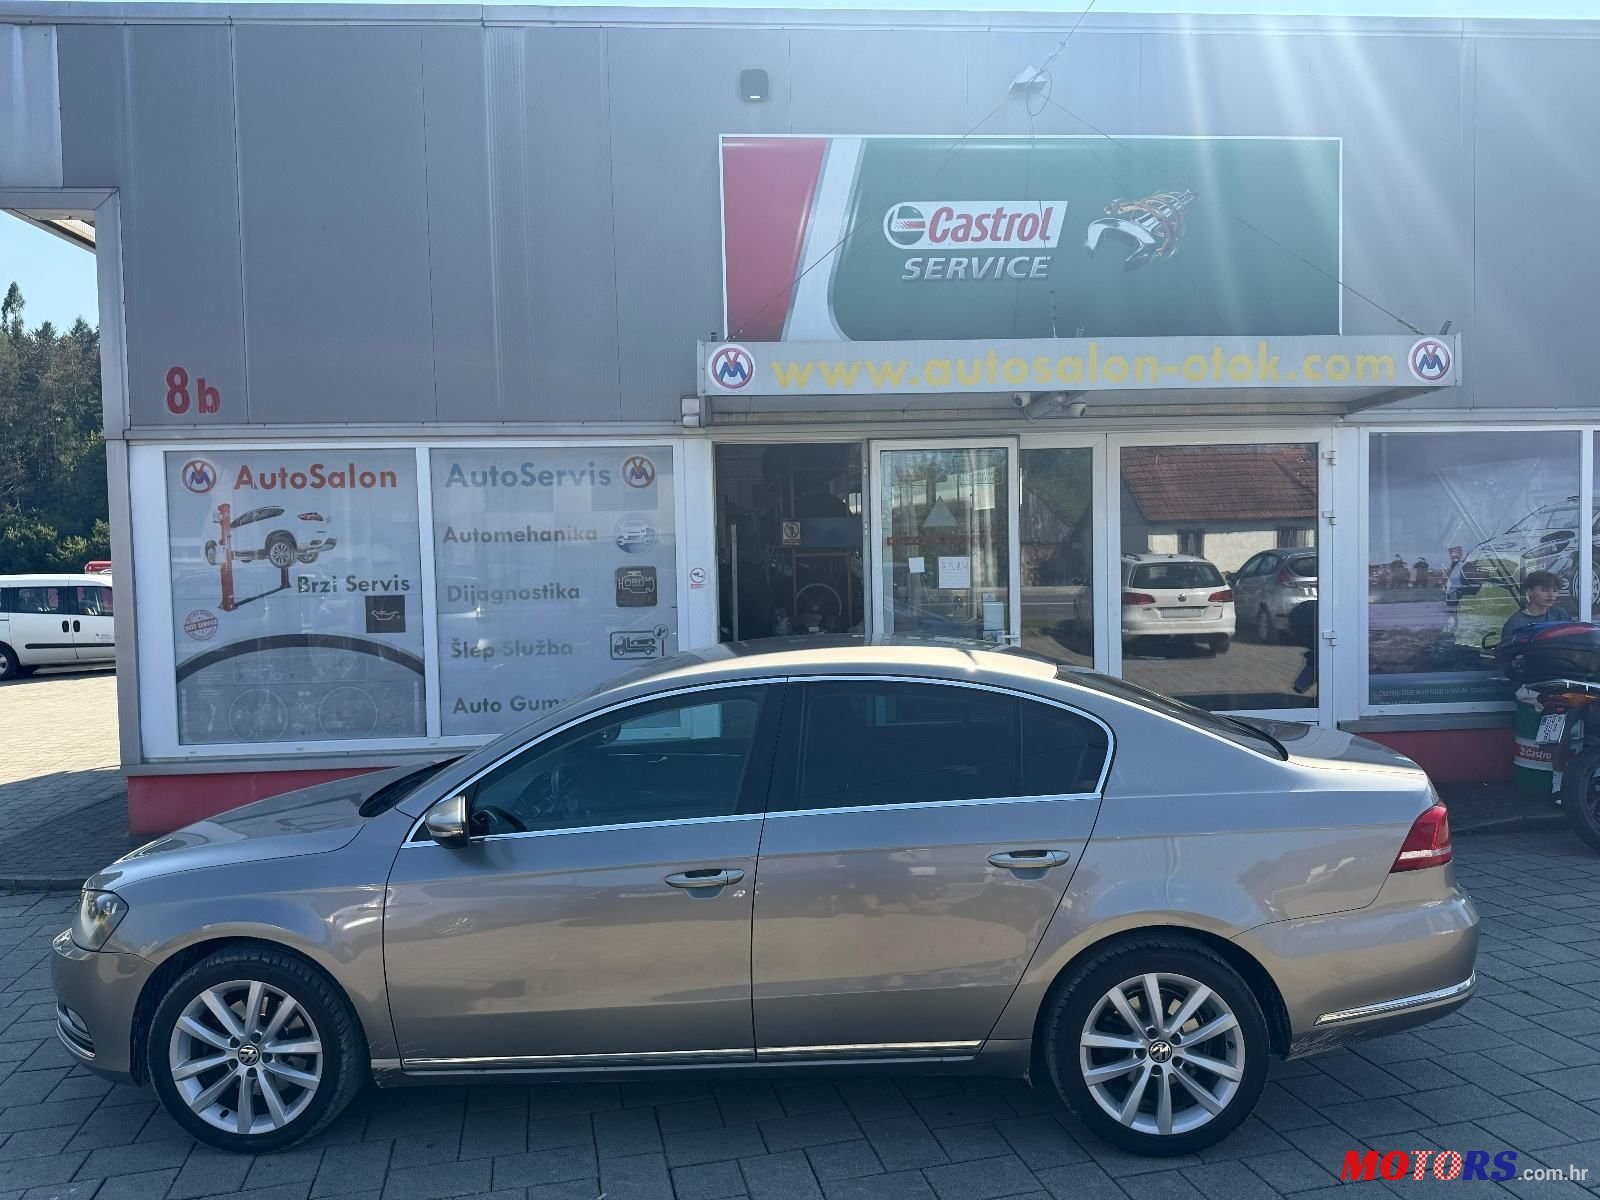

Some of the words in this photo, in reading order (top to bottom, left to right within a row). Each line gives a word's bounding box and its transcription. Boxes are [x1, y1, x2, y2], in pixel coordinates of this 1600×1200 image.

[928, 206, 1054, 244] Castrol
[901, 255, 1052, 281] SERVICE
[772, 341, 1394, 390] www.autosalon-otok.com
[166, 366, 221, 414] 8b
[233, 462, 398, 491] AutoSalon
[445, 461, 612, 489] AutoServis
[443, 525, 598, 545] Automehanika
[296, 574, 339, 594] Brzi
[346, 574, 411, 593] Servis
[446, 583, 581, 606] Dijagnostika
[450, 638, 496, 662] Šlep
[503, 637, 574, 657] Služba
[452, 697, 502, 714] Auto
